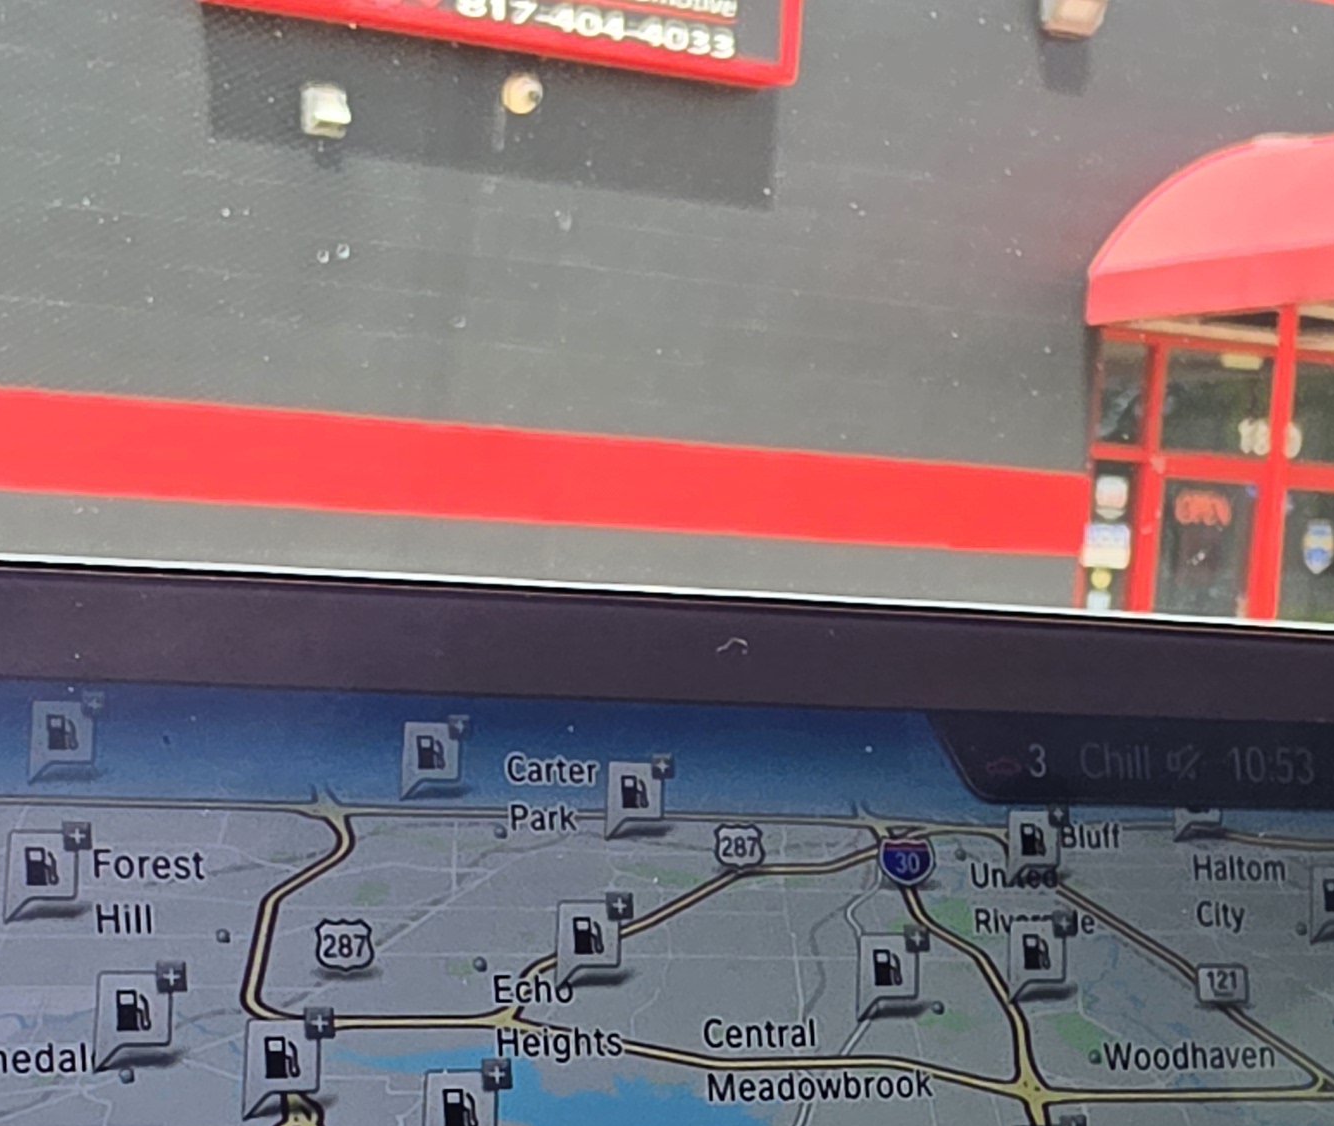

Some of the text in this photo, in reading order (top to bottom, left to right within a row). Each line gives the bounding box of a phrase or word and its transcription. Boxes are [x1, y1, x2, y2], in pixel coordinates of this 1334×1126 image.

[456, 0, 736, 59] 817-404-4033
[506, 755, 598, 784] Carter
[1028, 743, 1047, 778] 3
[1080, 743, 1151, 780] Chill
[1229, 745, 1315, 785] 10:53
[510, 804, 577, 832] Park
[720, 832, 760, 857] 287
[1061, 823, 1120, 849] Bluff
[92, 849, 204, 880] Forest
[895, 851, 921, 874] 30
[1194, 855, 1286, 882] Haltom
[96, 904, 153, 935] Hill
[1196, 901, 1245, 934] City
[322, 933, 364, 958] 287
[493, 976, 574, 1004] Echo
[1207, 970, 1238, 990] 121
[496, 1027, 624, 1062] Heights
[703, 1018, 816, 1049] Central
[1104, 1044, 1276, 1071] Woodhaven
[708, 1071, 934, 1103] Meadowbrook
